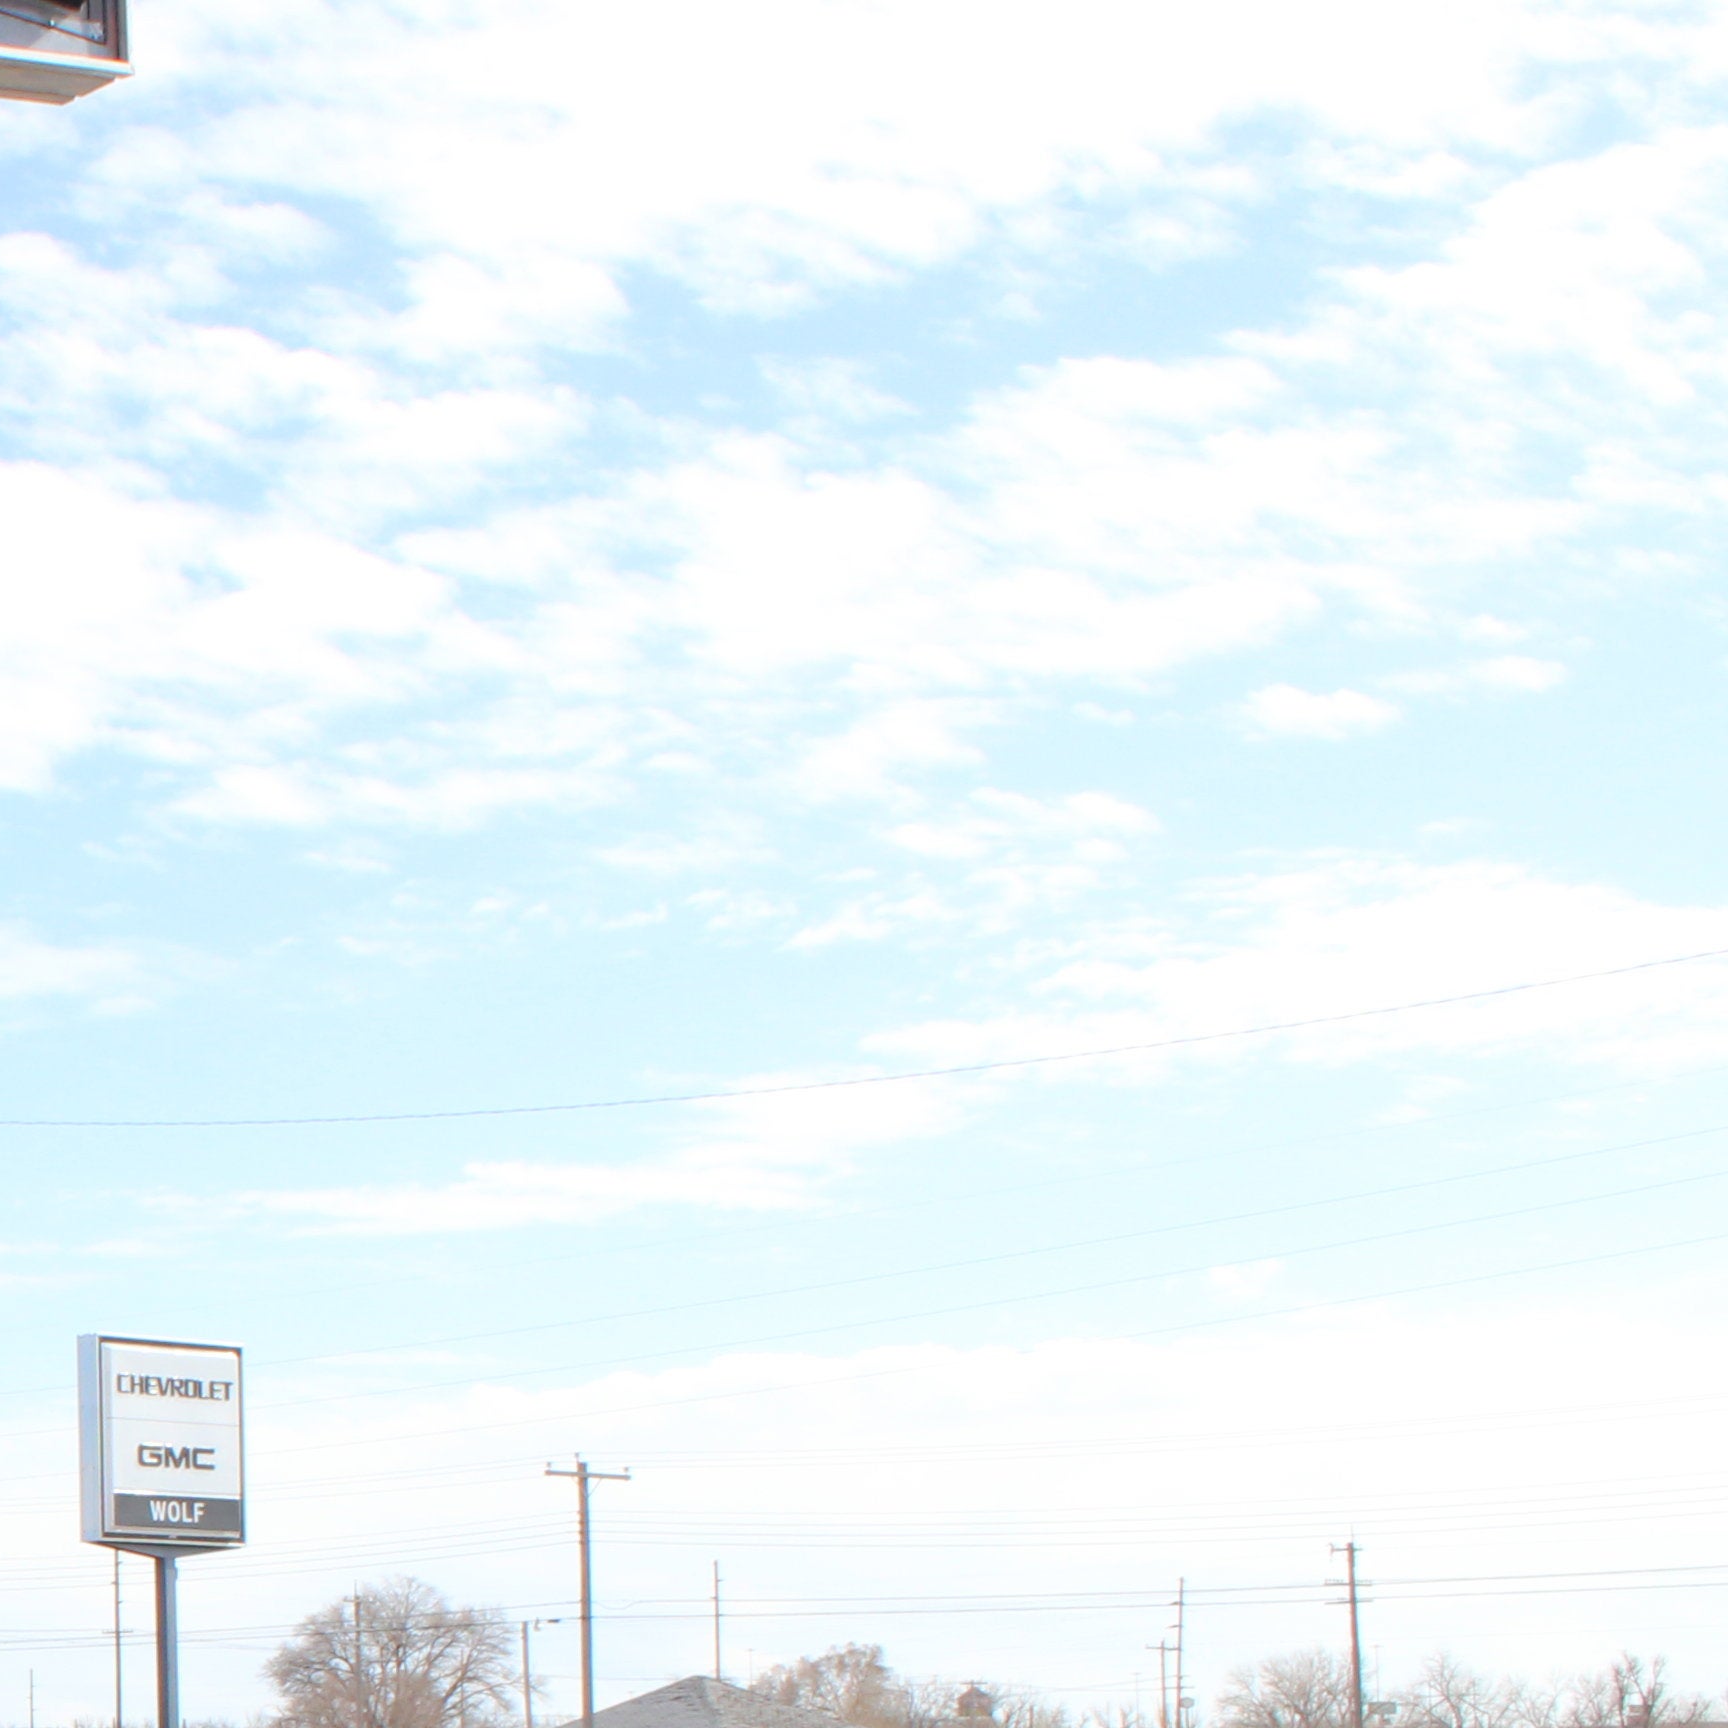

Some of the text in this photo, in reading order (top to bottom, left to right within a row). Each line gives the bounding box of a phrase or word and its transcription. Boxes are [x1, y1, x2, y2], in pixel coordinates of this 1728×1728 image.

[116, 1374, 234, 1401] CHEVROLET
[137, 1444, 216, 1470] GMC
[149, 1500, 206, 1524] WOLF
